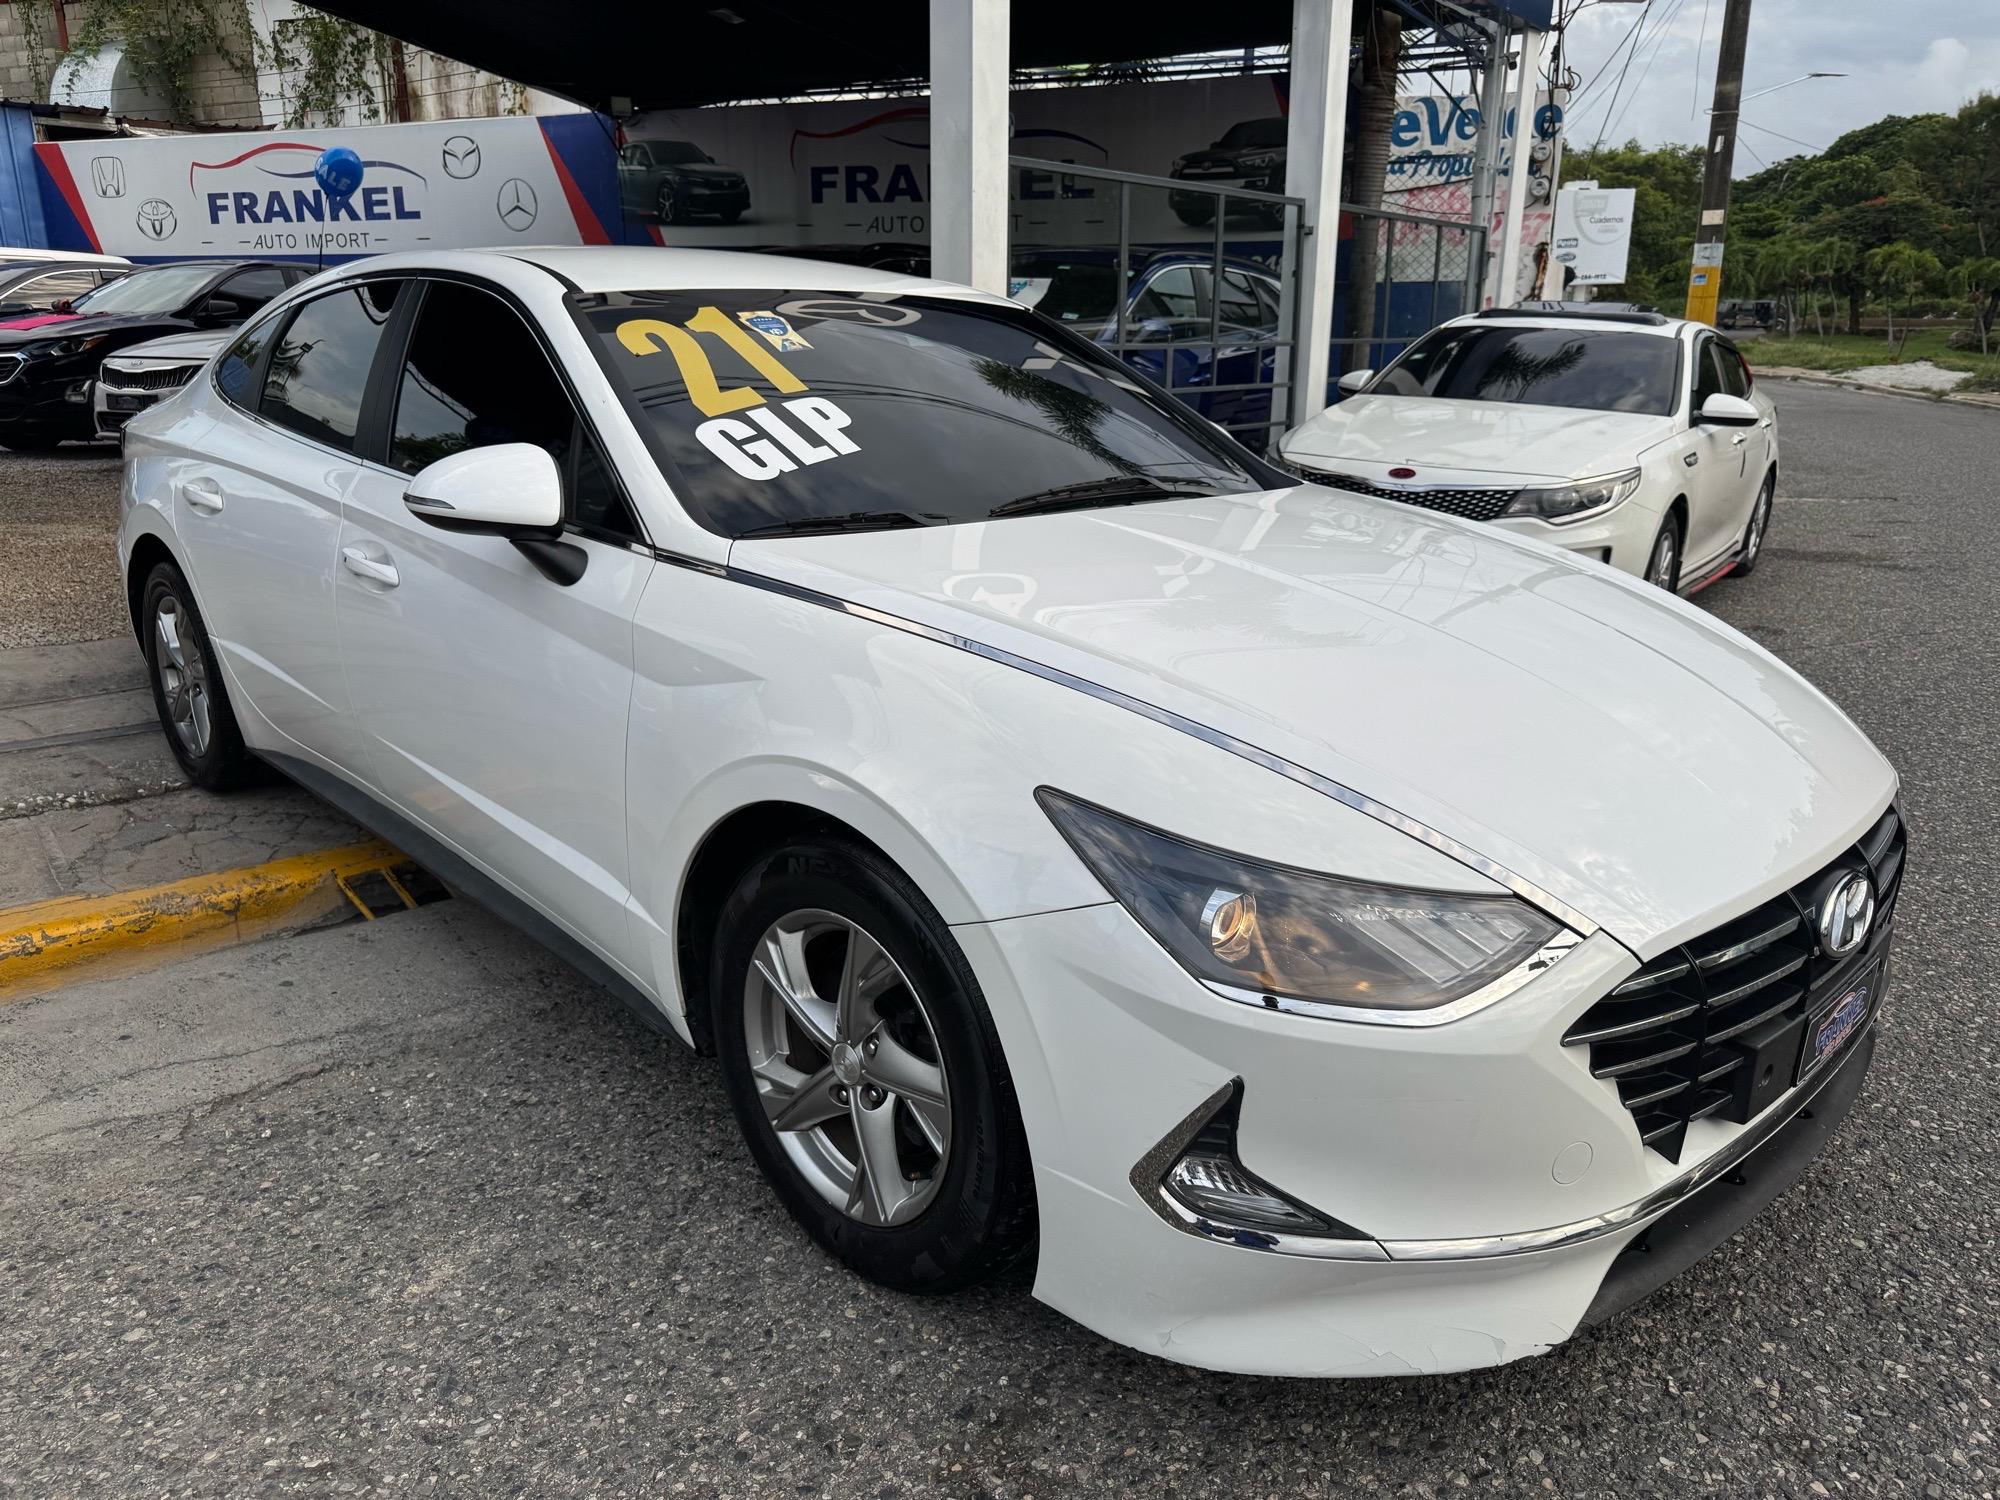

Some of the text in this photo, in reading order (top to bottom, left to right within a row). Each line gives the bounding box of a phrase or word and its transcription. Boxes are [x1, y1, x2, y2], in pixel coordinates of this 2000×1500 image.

[315, 156, 351, 191] SALE
[207, 186, 421, 225] FRANKEL
[253, 232, 370, 249] AUTO IMPORT
[866, 215, 925, 234] AUTO
[616, 306, 810, 417] 21
[695, 396, 862, 481] GLP
